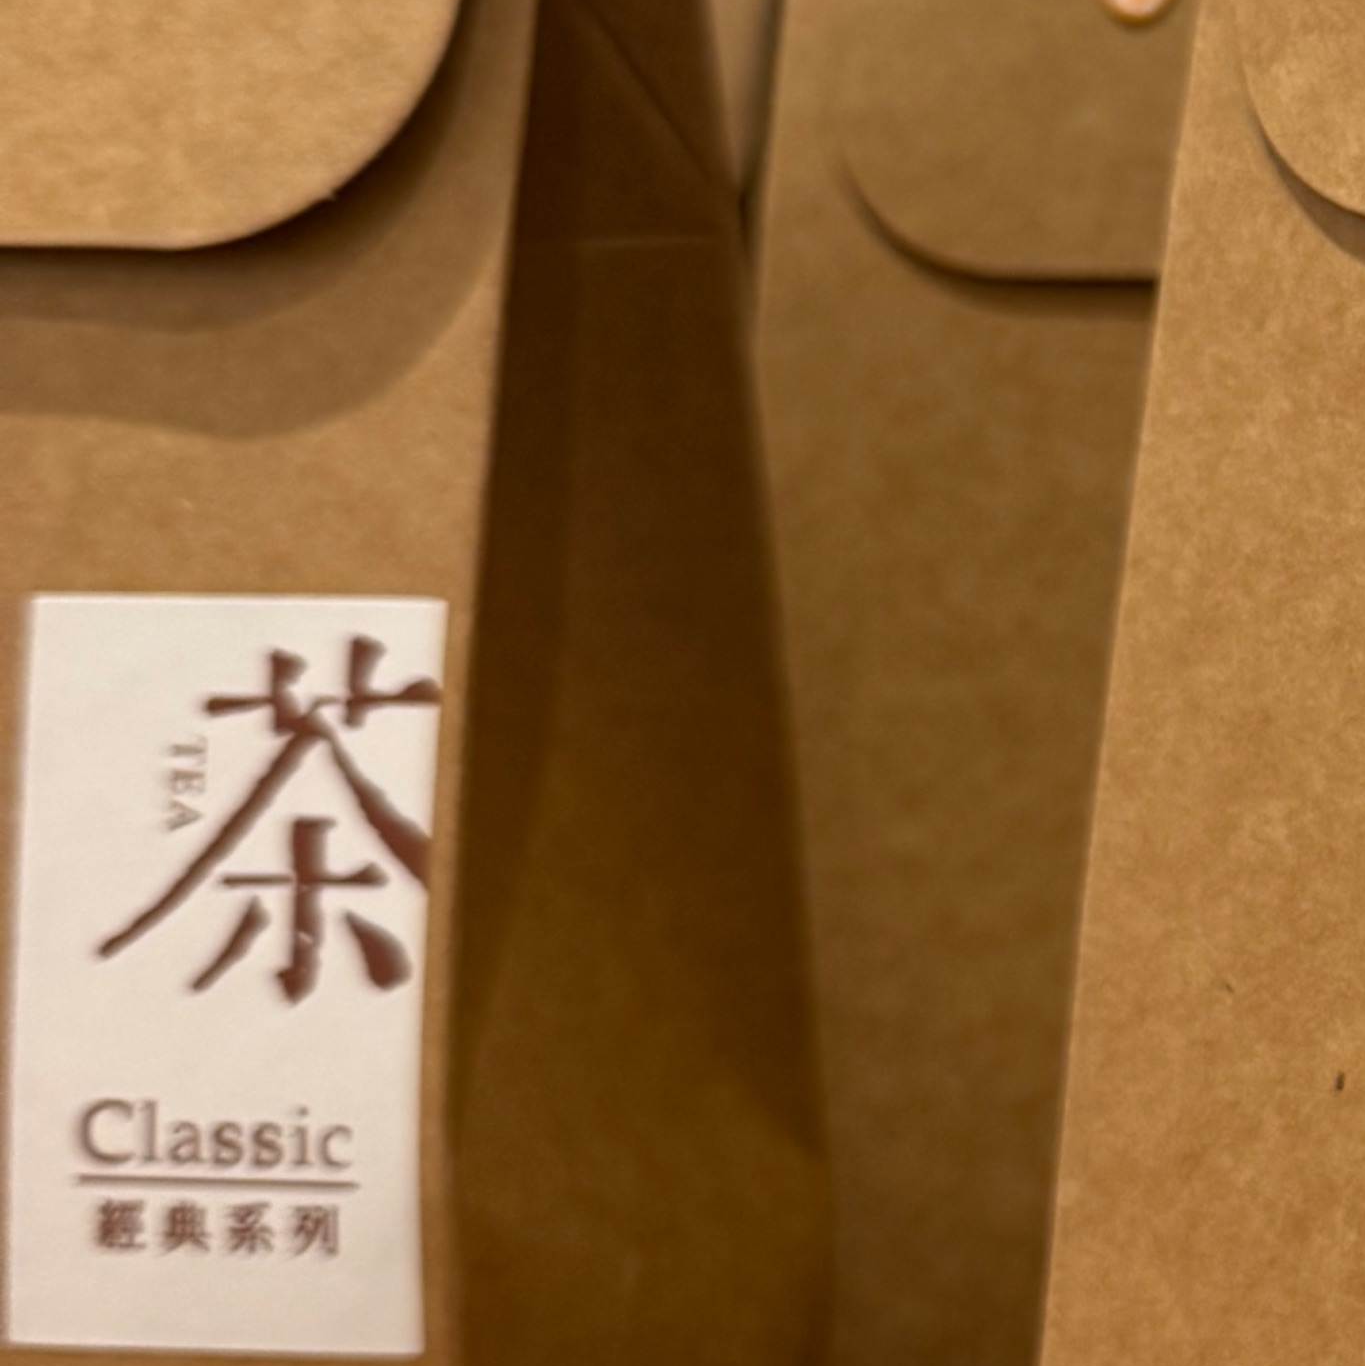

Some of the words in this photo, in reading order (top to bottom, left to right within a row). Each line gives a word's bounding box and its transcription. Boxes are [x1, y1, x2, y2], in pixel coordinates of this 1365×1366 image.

[96, 635, 441, 1006] 茶
[166, 734, 206, 832] TEA
[78, 1097, 354, 1169] Classic
[95, 1198, 340, 1258] 經典系列
